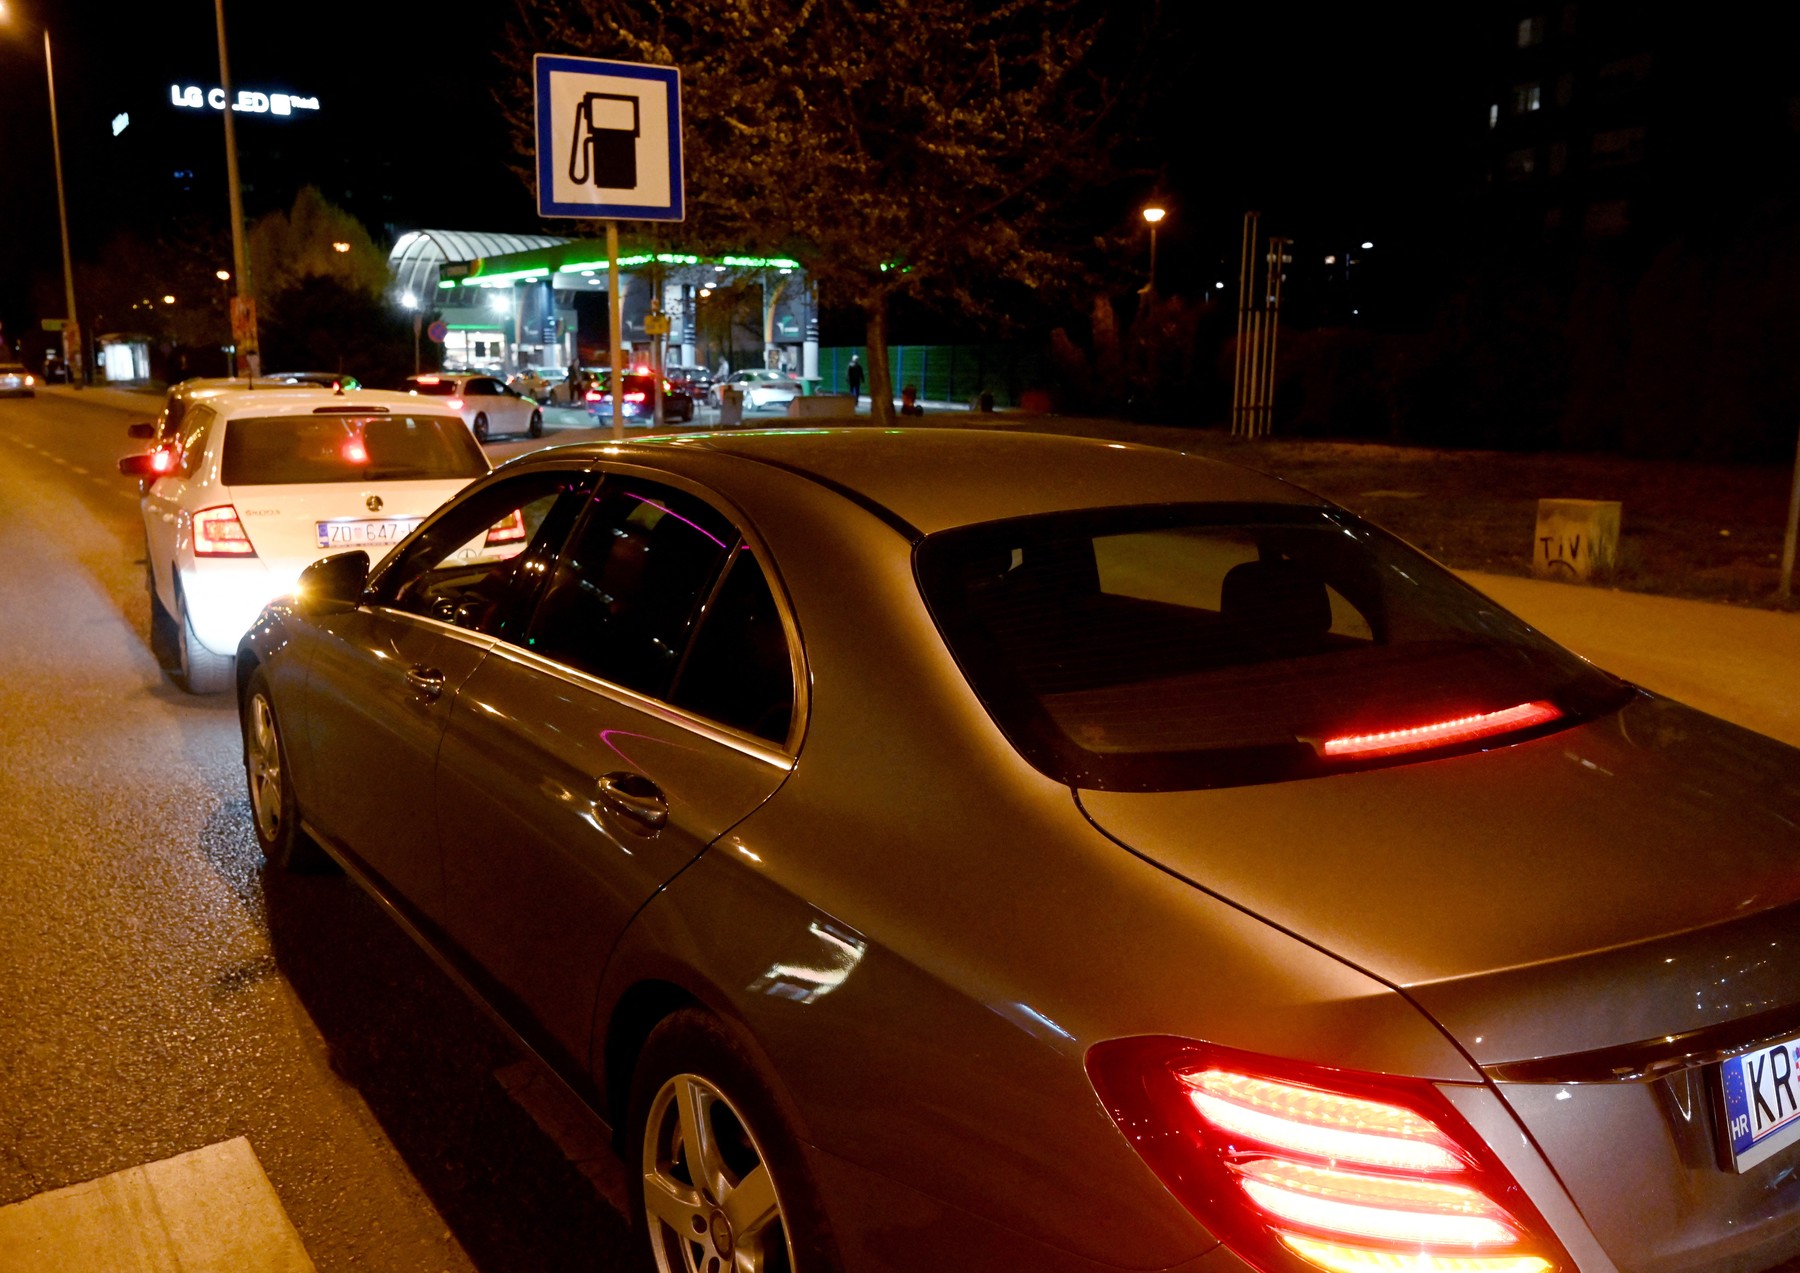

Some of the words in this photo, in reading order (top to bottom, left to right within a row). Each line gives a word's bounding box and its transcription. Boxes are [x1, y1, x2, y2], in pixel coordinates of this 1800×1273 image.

[171, 84, 203, 108] LG
[330, 525, 352, 543] ZD
[1748, 1045, 1798, 1131] KR
[1731, 1114, 1749, 1140] HR
